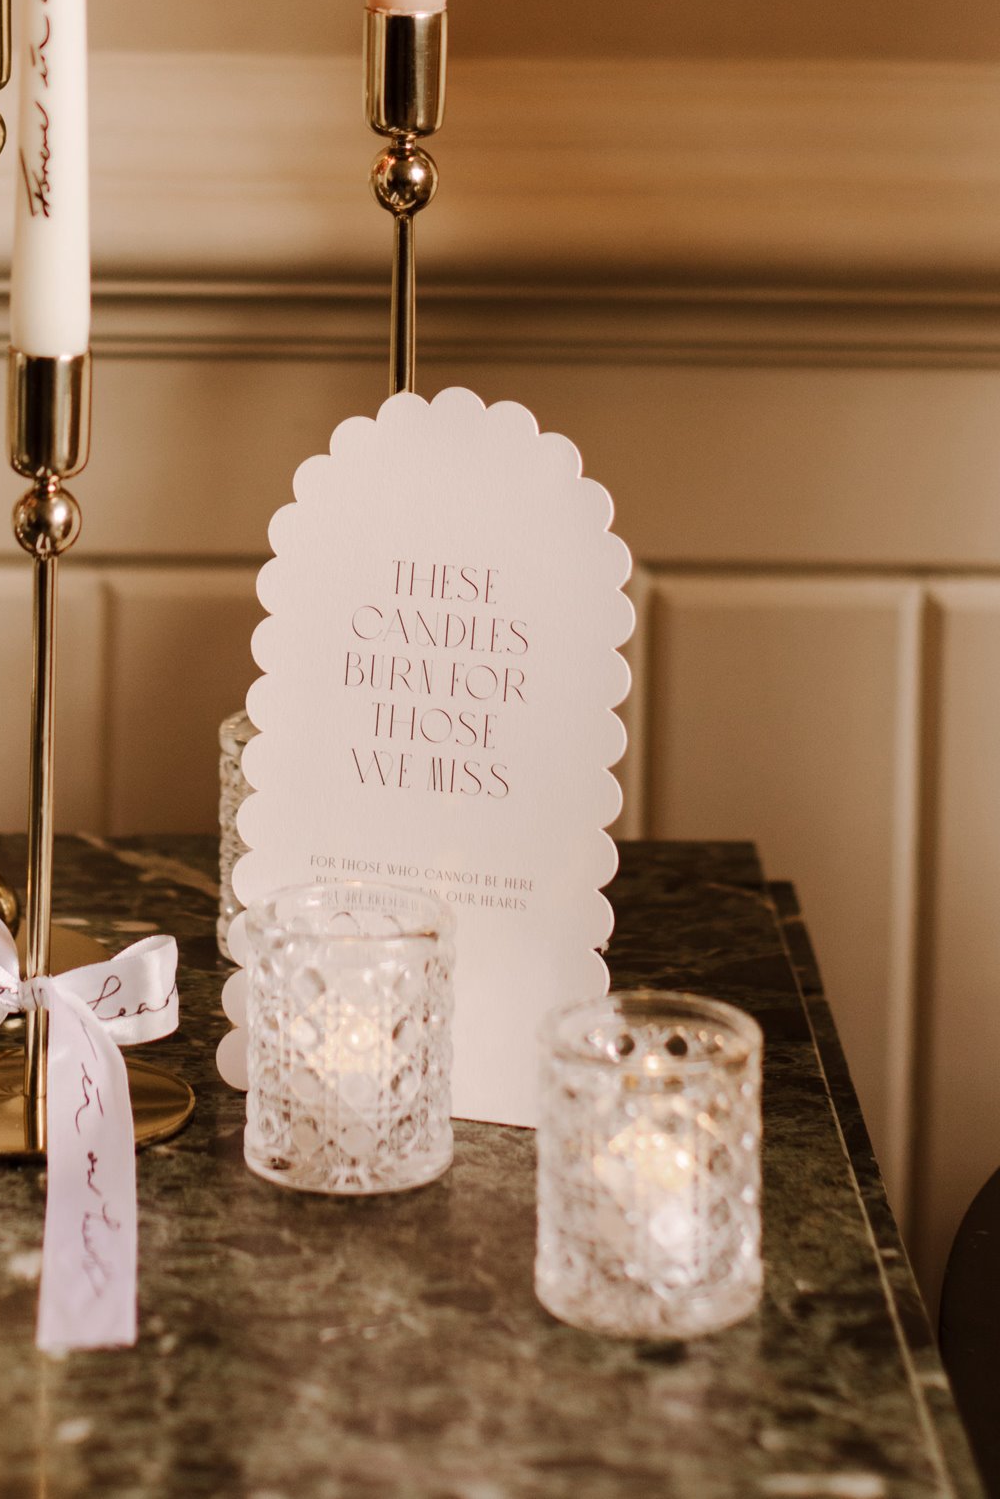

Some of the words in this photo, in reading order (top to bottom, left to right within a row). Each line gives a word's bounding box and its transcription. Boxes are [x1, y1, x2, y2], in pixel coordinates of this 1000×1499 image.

[392, 559, 500, 605] THESE
[351, 604, 529, 656] CANDLES
[344, 651, 434, 695] BURN
[450, 662, 528, 704] FOR
[371, 701, 498, 750] THOSE
[351, 747, 413, 789] WE
[426, 756, 509, 800] MISS
[310, 854, 337, 869] FOR
[341, 857, 382, 875] THOSE
[387, 862, 419, 878] WHO
[424, 867, 479, 886] CANNOT
[484, 874, 497, 888] BE
[504, 876, 534, 892] HERE
[446, 890, 476, 906] OUR
[480, 894, 528, 912] HEARTS
